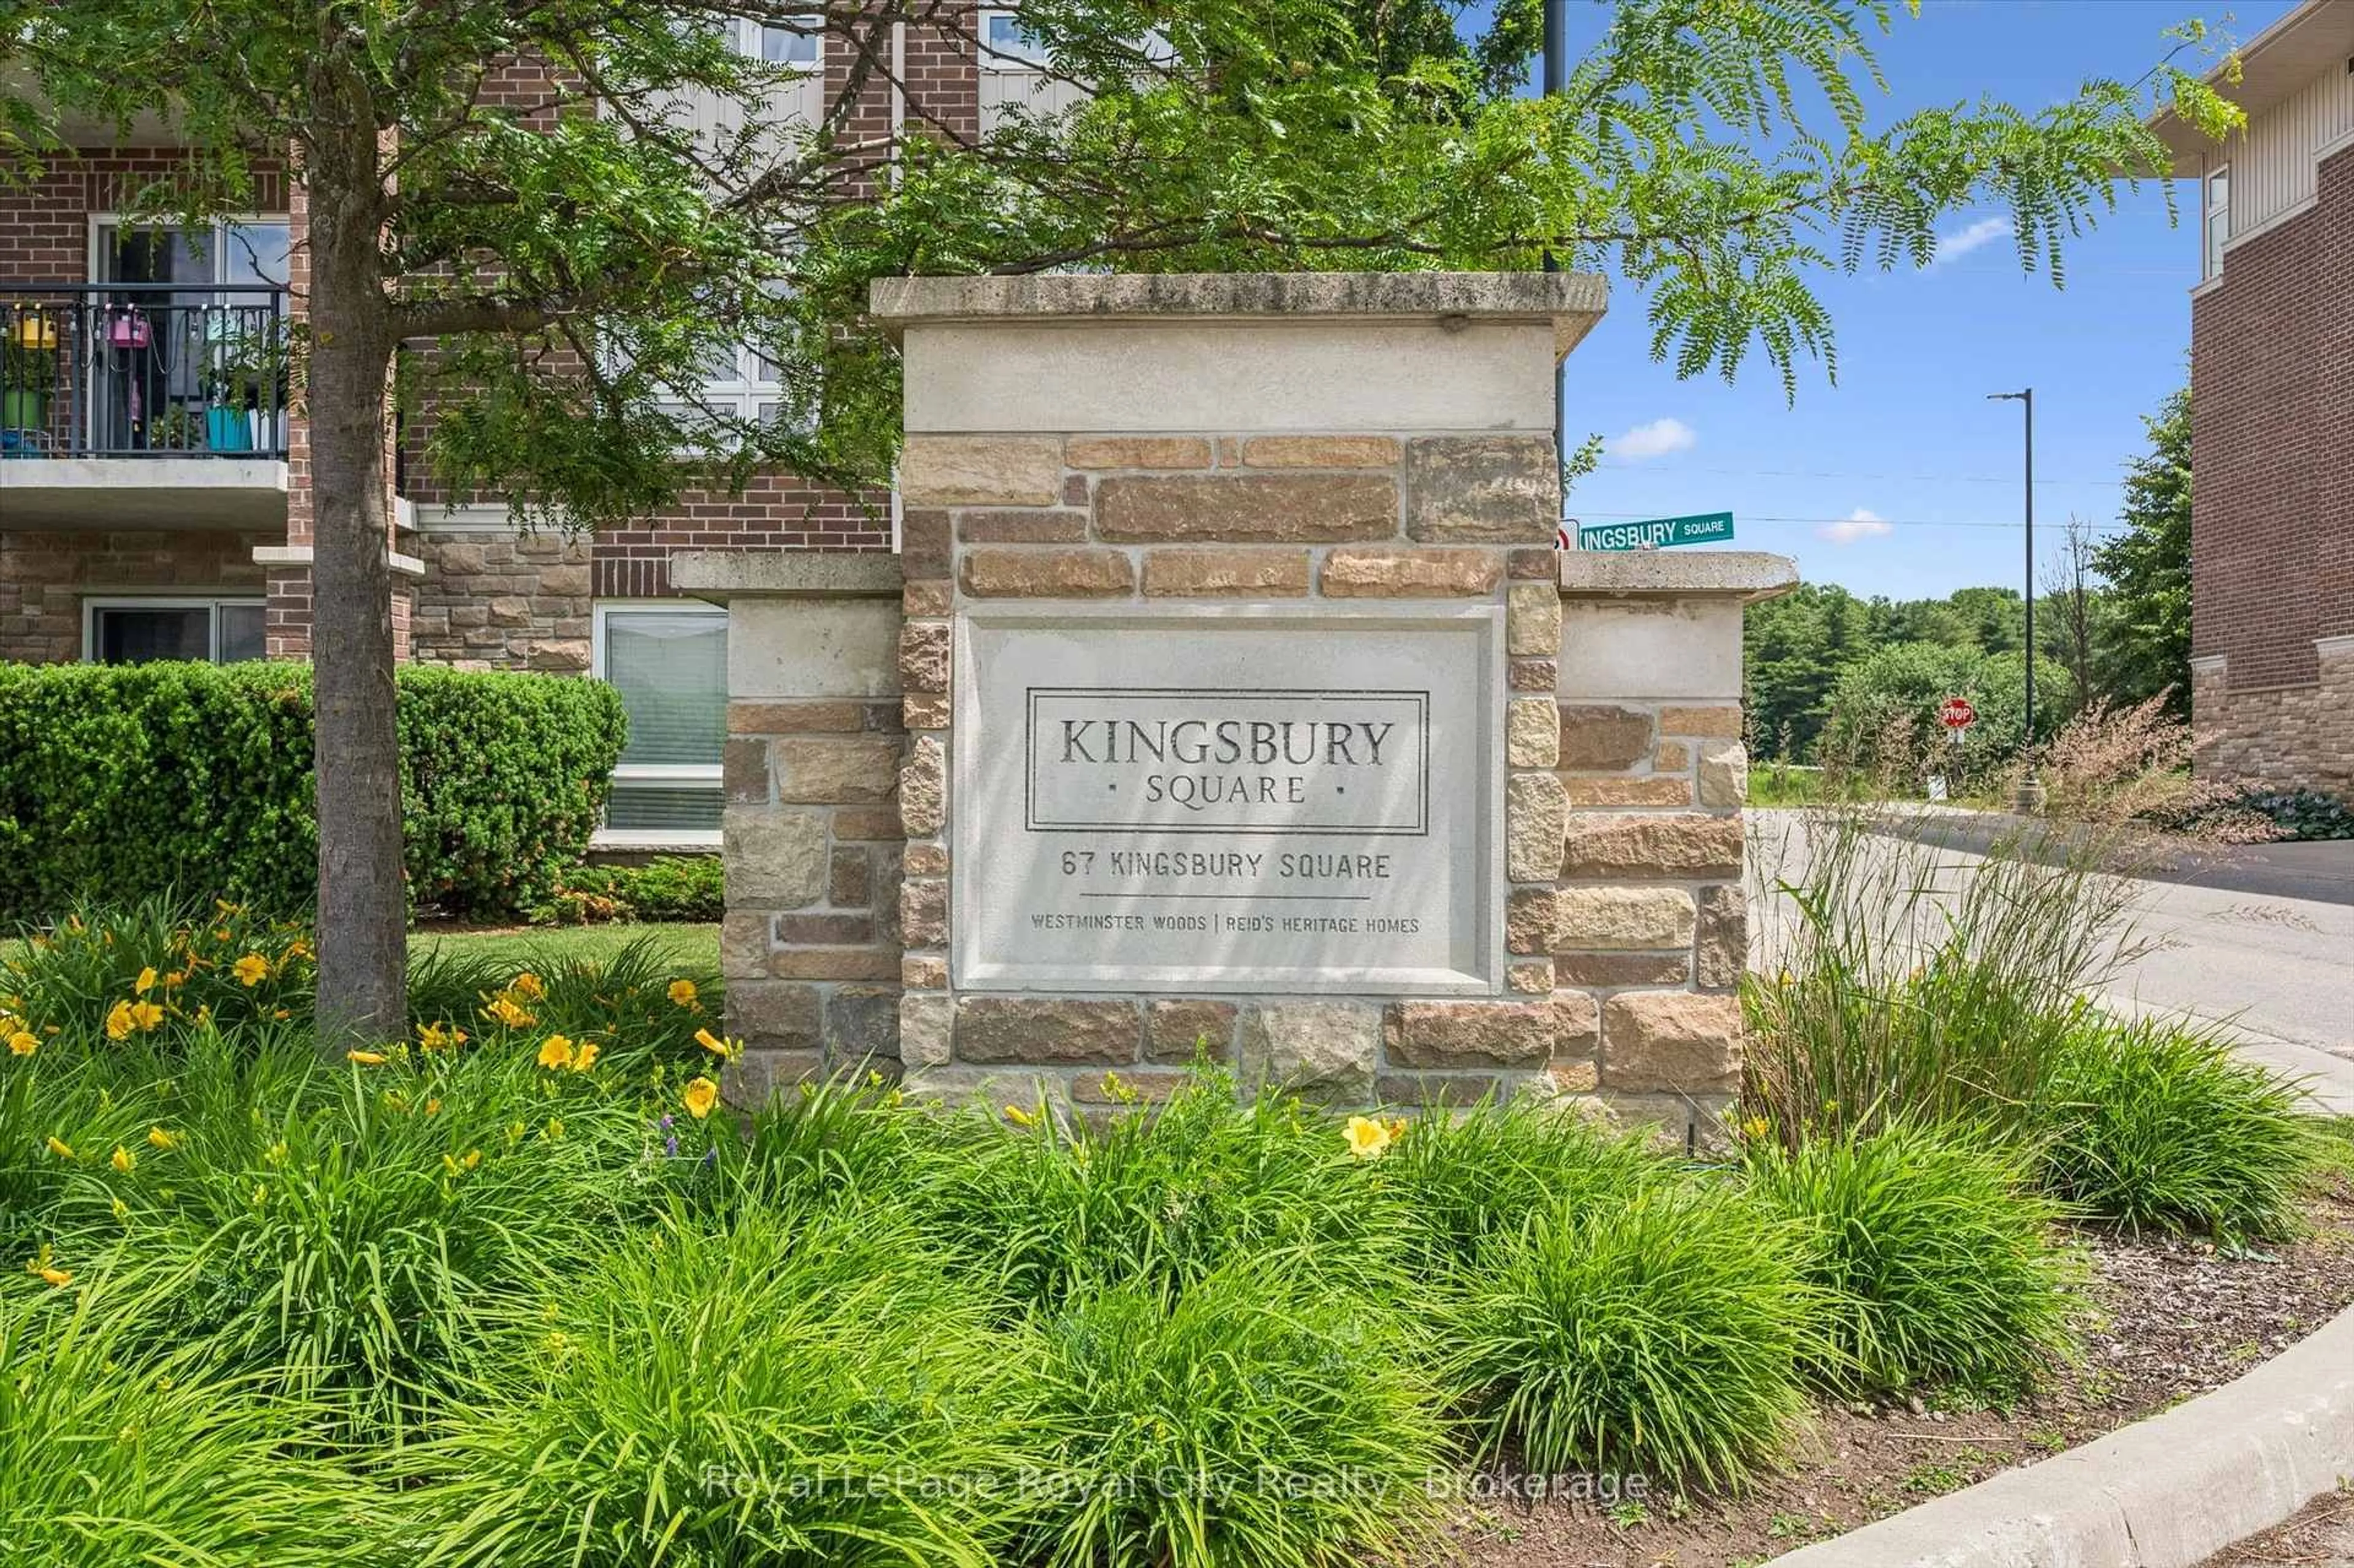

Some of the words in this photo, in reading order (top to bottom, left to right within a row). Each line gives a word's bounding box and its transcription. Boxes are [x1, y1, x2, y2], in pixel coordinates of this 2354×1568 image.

[1580, 522, 1677, 550] INGSBURY
[1683, 520, 1724, 536] SQUARE
[1943, 707, 1970, 720] STOP
[1059, 720, 1395, 766] KINGSBURY
[1146, 775, 1305, 810] SQUARE
[1062, 851, 1095, 875] 67
[1110, 851, 1262, 877] KINGSBURY
[1279, 853, 1390, 878] SQUARE
[1031, 913, 1145, 931] WESTMINSTER
[1153, 916, 1206, 931] WOODS
[1226, 915, 1274, 932] REID'S
[1282, 918, 1358, 933] HERITAGE
[1366, 919, 1419, 934] HOMES
